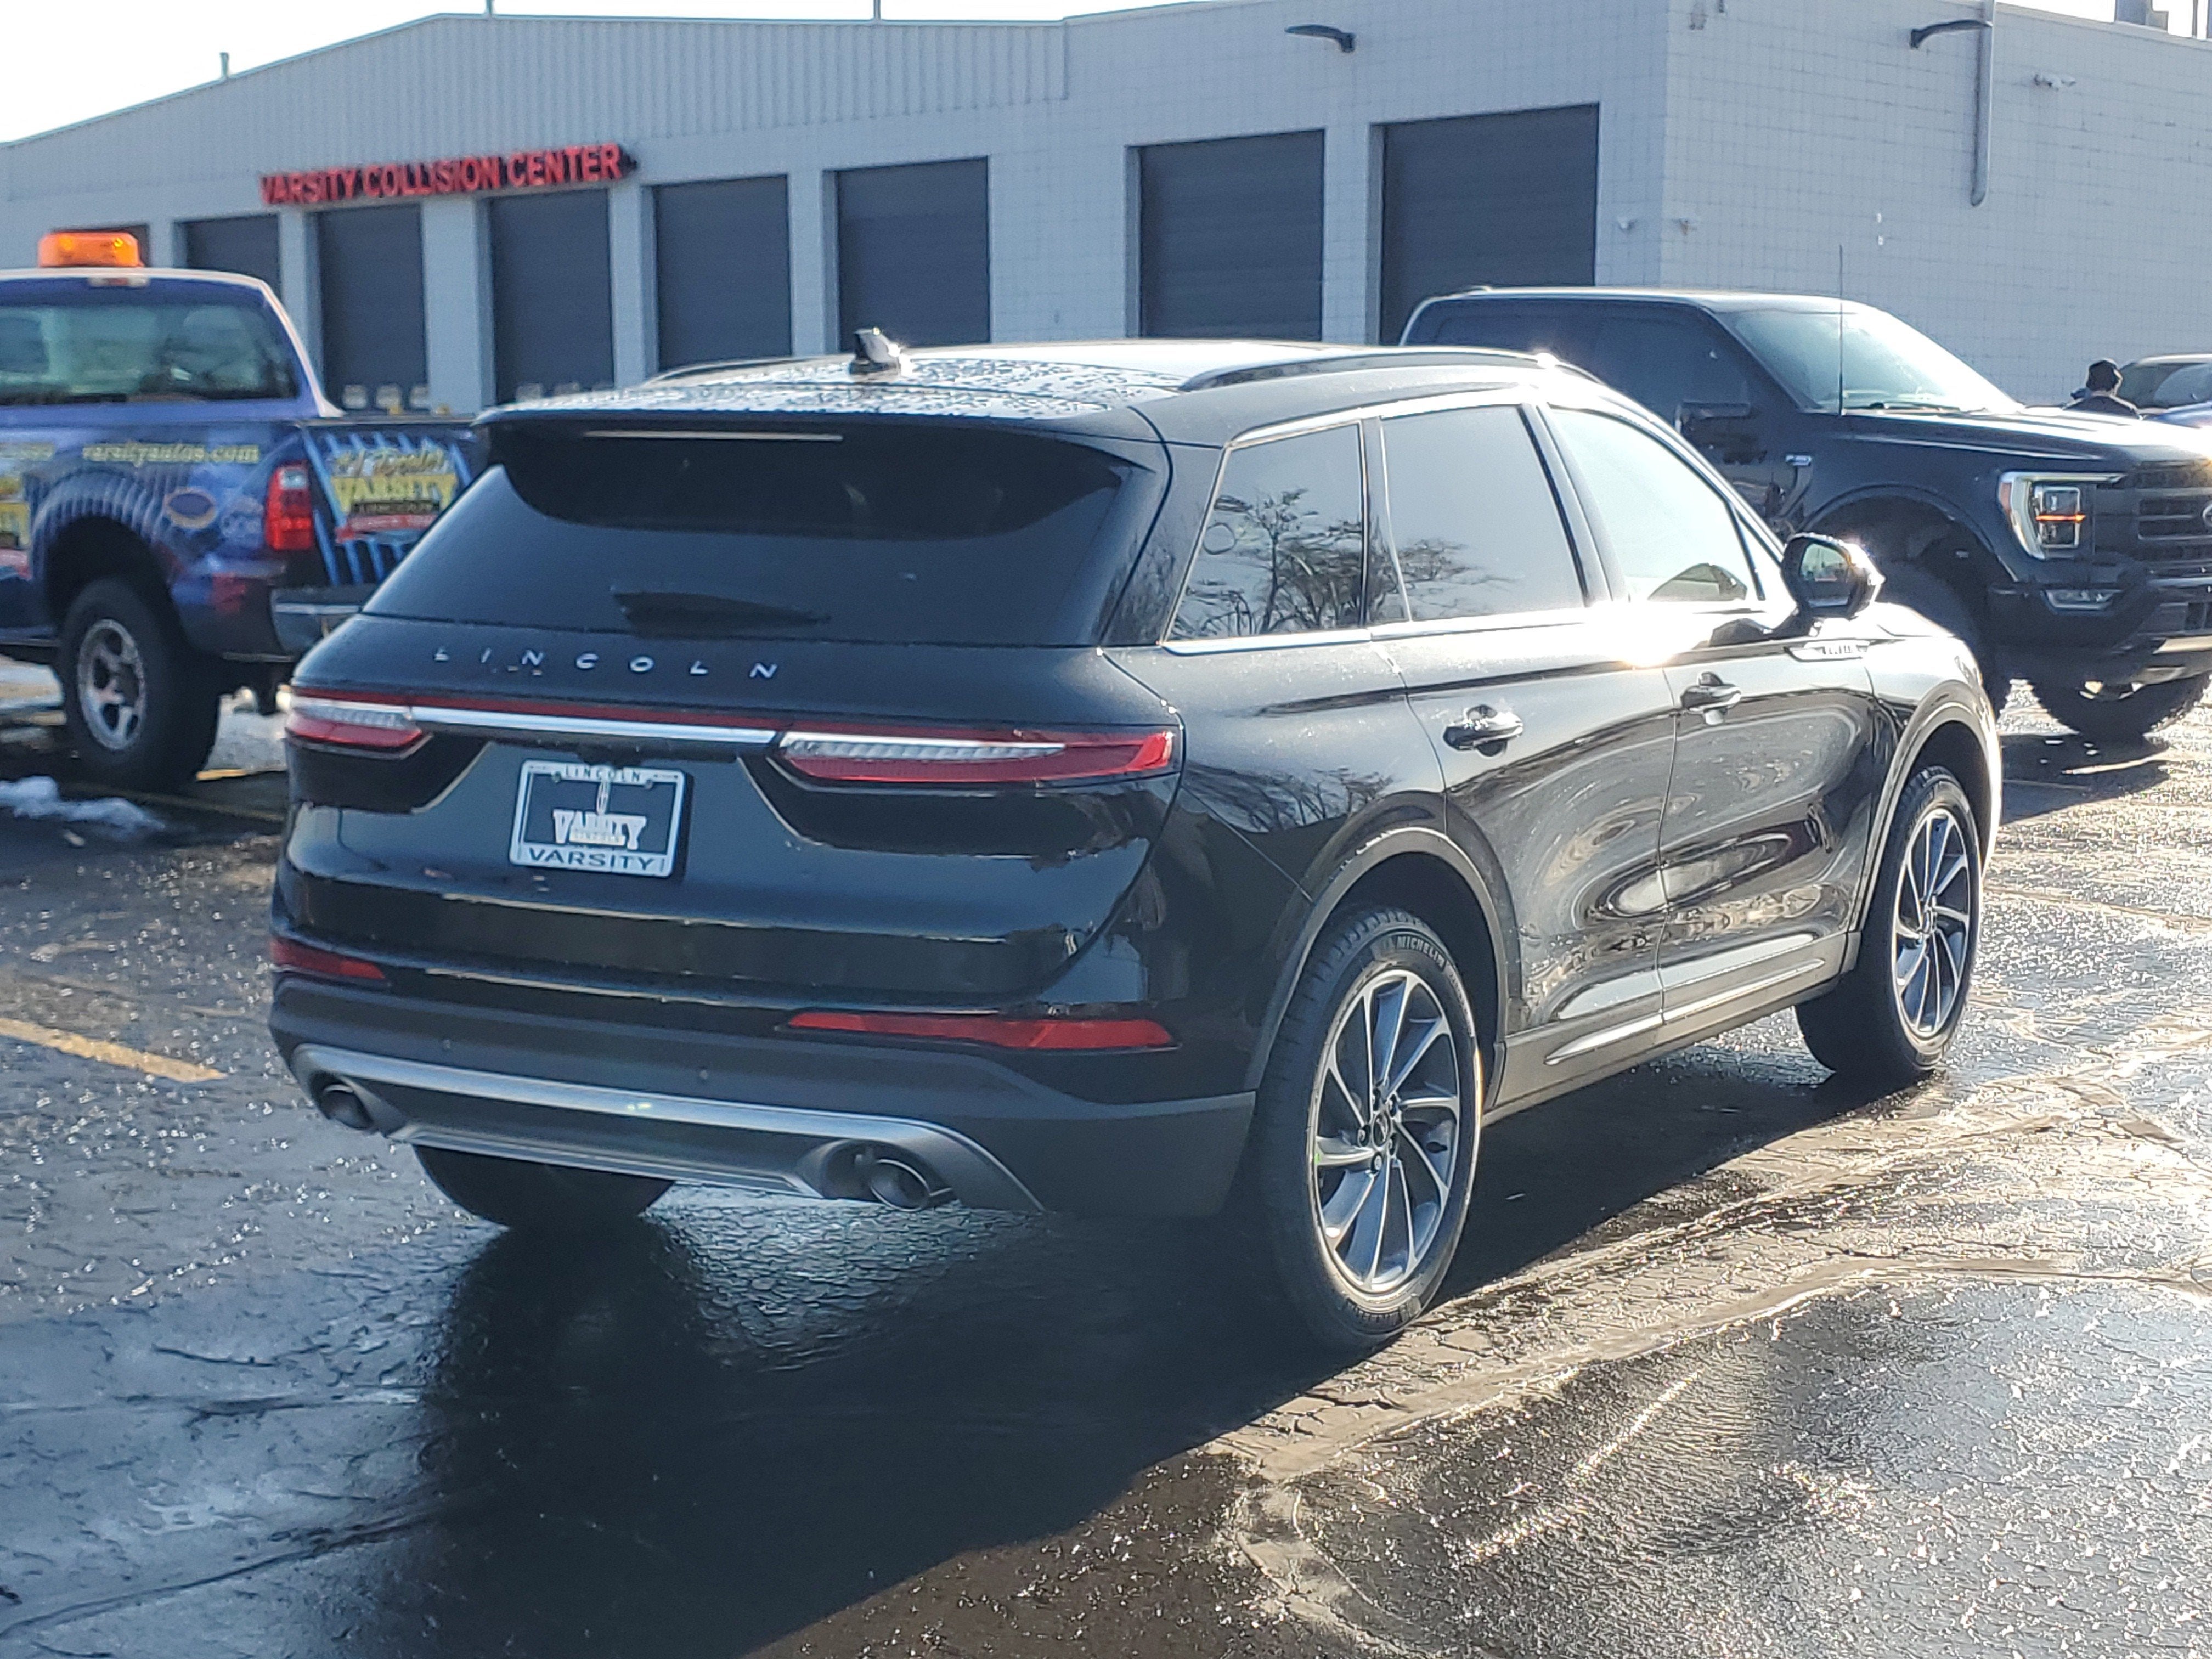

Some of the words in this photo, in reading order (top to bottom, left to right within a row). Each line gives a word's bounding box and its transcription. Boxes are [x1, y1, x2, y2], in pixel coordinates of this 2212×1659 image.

[259, 169, 360, 205] VARSITY
[362, 156, 501, 198] COLLISION
[507, 143, 623, 188] CENTER
[434, 647, 777, 678] LINCOLN
[529, 847, 654, 871] VARSITY
[1397, 935, 1447, 969] MICHELIN
